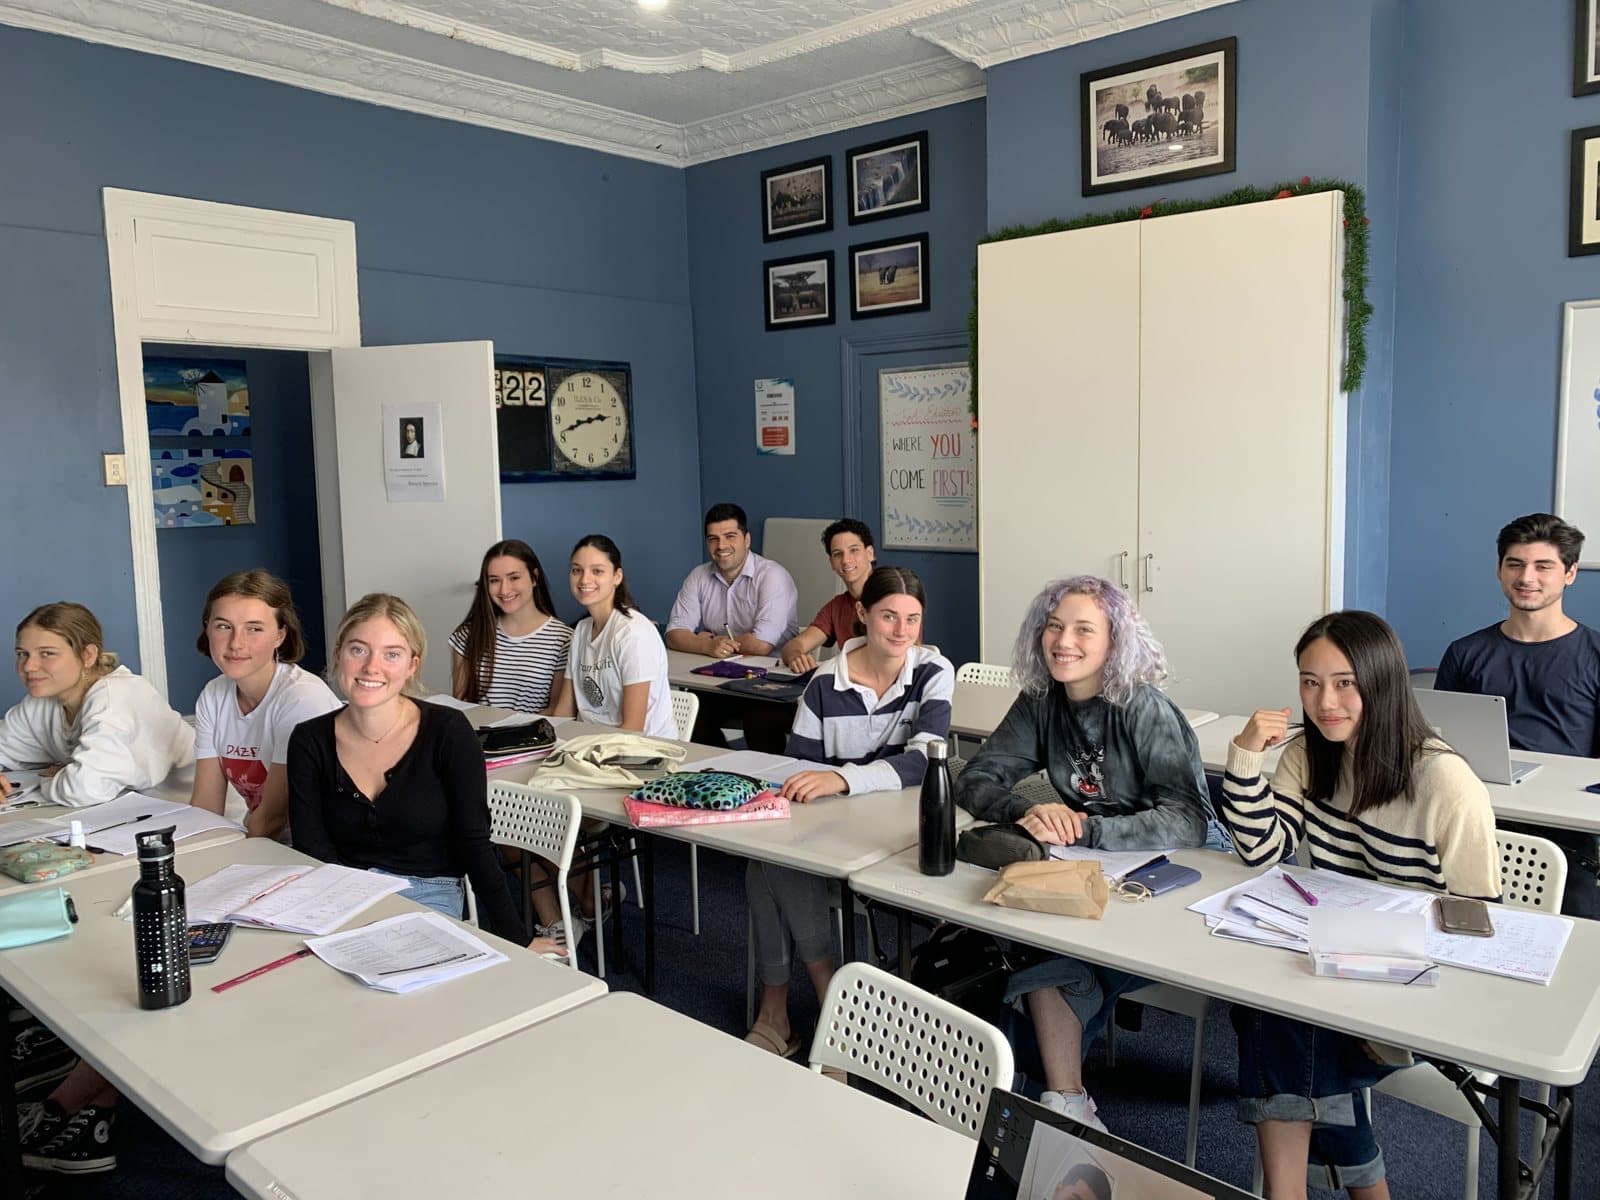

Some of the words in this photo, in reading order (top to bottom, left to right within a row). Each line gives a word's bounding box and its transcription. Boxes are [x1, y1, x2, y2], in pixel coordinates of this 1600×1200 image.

[567, 382, 575, 392] 11
[582, 377, 592, 388] 12
[506, 375, 543, 401] 22
[600, 383, 605, 393] 1
[557, 397, 566, 407] 10
[610, 398, 617, 408] 2
[554, 415, 561, 425] 9
[615, 416, 621, 426] 3
[560, 433, 567, 443] 8
[612, 433, 618, 444] 4
[892, 435, 922, 451] WHERE
[930, 431, 961, 458] YOU
[572, 448, 578, 458] 7
[588, 453, 594, 463] 6
[603, 448, 609, 458] 5
[890, 468, 926, 490] COME
[932, 469, 970, 497] FIRST!
